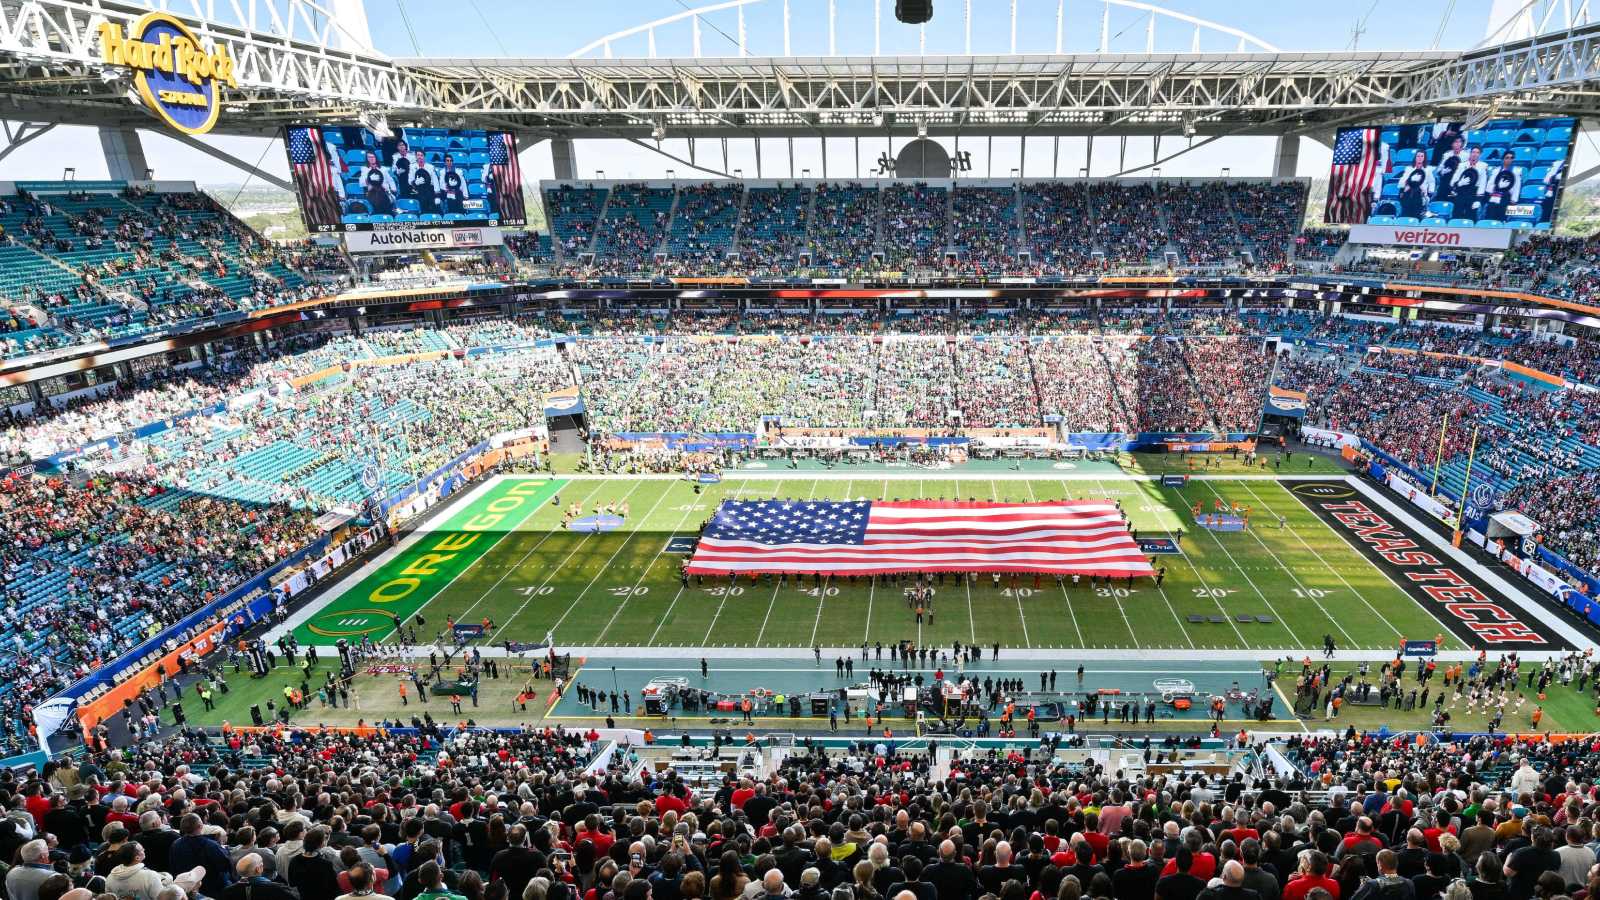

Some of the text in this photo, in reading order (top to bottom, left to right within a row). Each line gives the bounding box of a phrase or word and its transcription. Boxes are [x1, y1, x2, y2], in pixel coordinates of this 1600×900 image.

[97, 21, 239, 90] Hard Rock
[370, 231, 446, 245] AutoNation
[1394, 228, 1460, 245] verizon
[369, 480, 547, 603] OREGON
[1320, 500, 1549, 644] TEXAS TECH
[522, 586, 555, 596] 10
[613, 586, 649, 596] 20
[711, 586, 745, 596] 30
[806, 586, 840, 597] 40
[999, 587, 1034, 597] 40
[1096, 587, 1131, 598] 30
[1191, 588, 1228, 598] 20
[1291, 588, 1326, 598] 10
